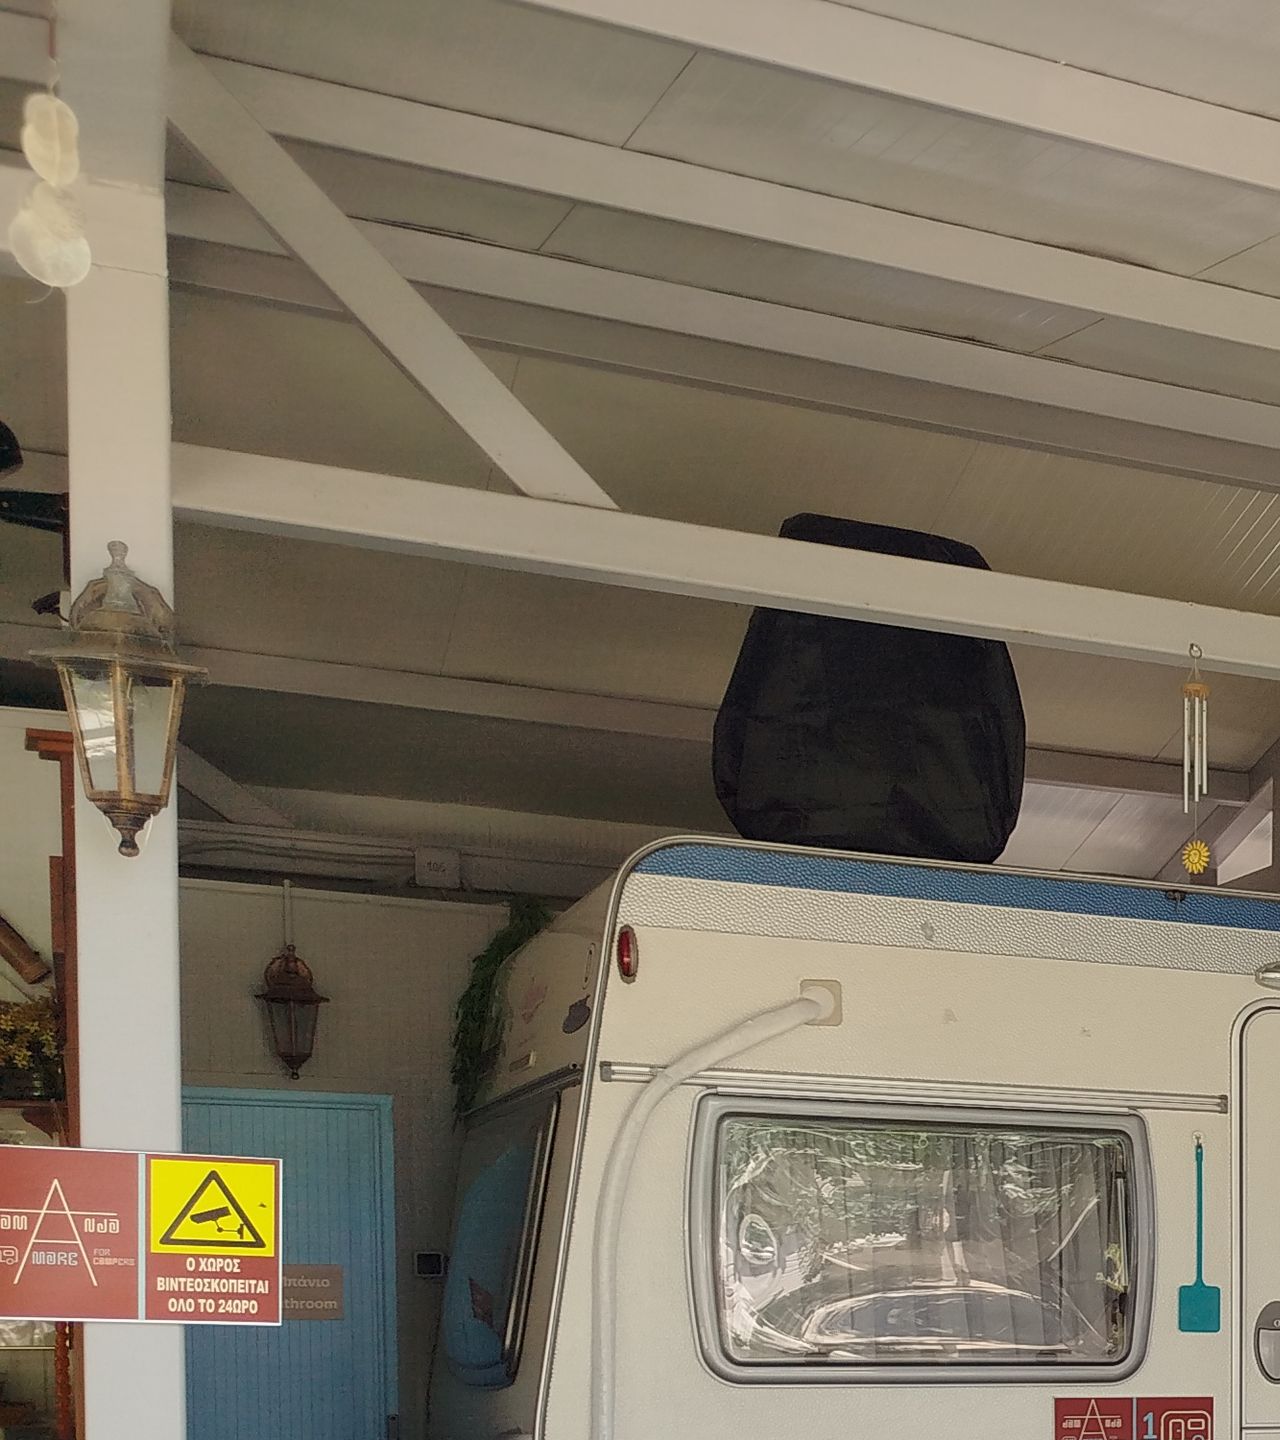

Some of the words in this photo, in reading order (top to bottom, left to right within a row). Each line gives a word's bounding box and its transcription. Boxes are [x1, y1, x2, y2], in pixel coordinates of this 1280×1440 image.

[199, 1257, 241, 1273] ΧΩΡΟΣ
[156, 1277, 269, 1294] ΒΙΝΤΕΟΣΚΟΠΕΙΤΑΙ
[168, 1298, 195, 1312] ΟΛΟ
[199, 1299, 215, 1313] ΤΟ
[218, 1300, 258, 1314] 24ΩΡΟ
[284, 1298, 338, 1309] throom
[1141, 1412, 1157, 1440] 1
